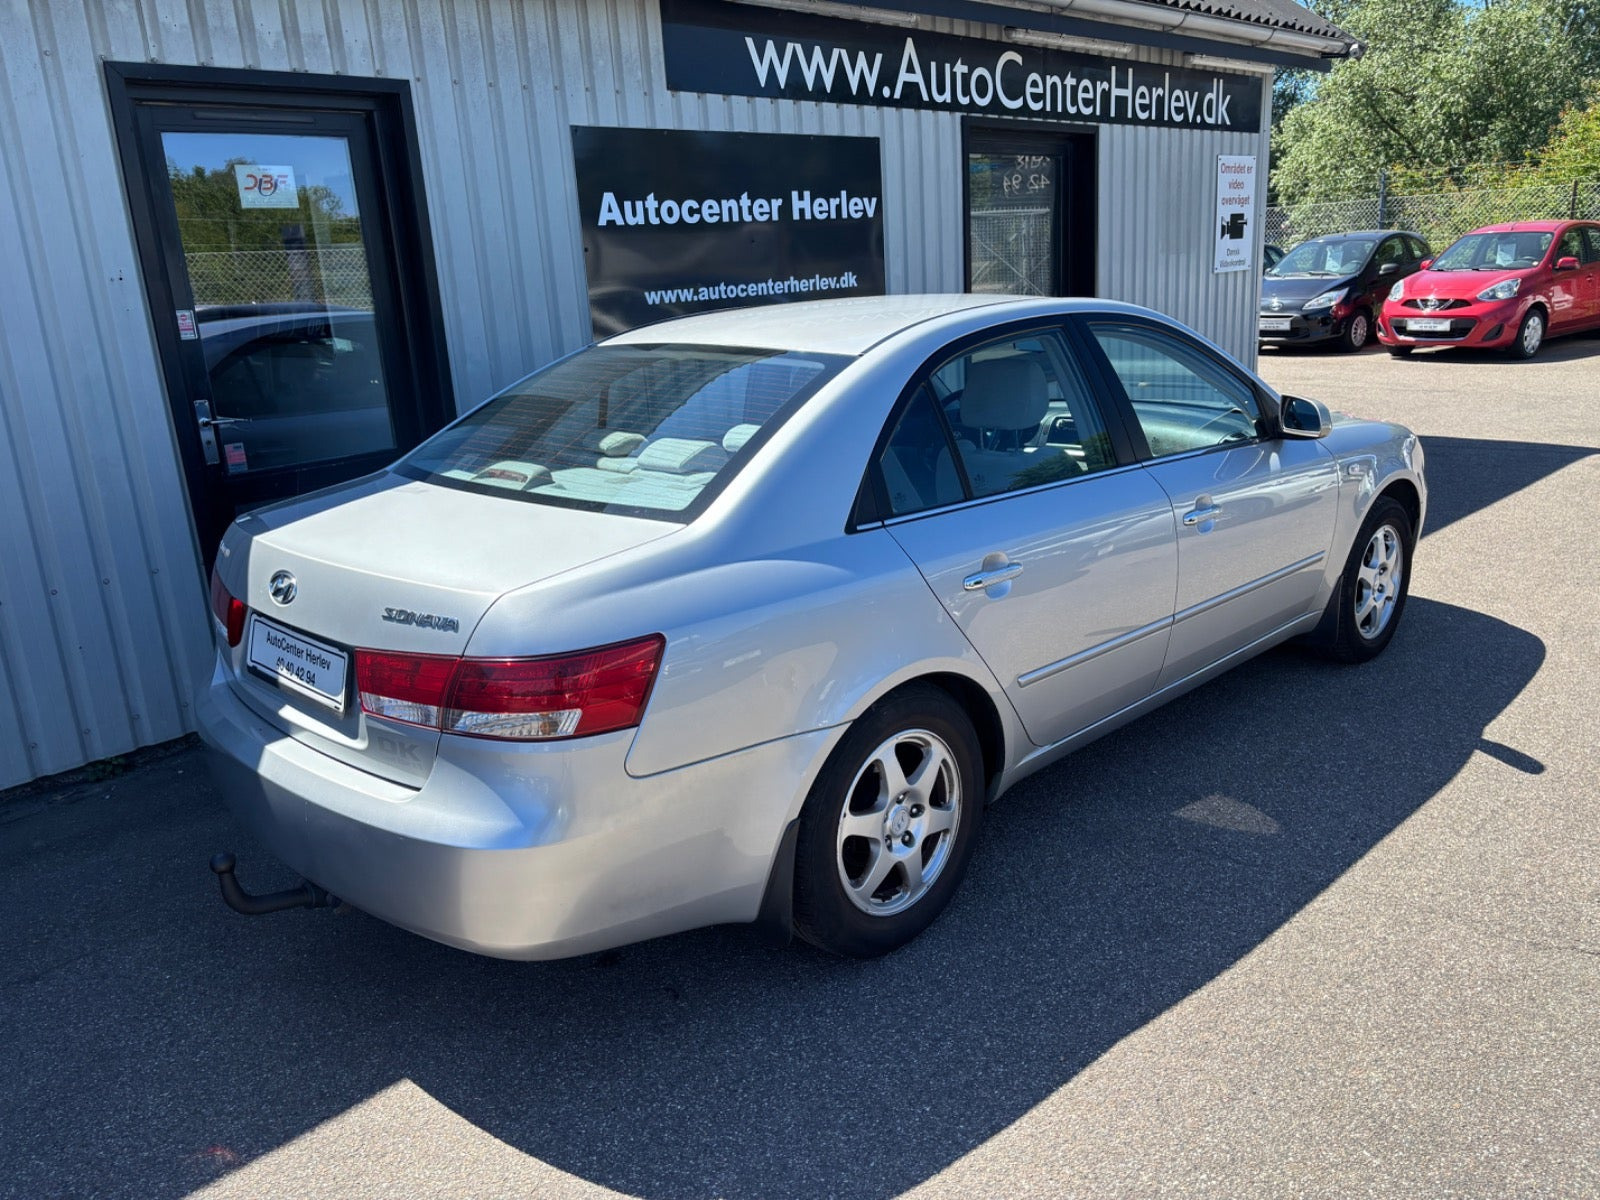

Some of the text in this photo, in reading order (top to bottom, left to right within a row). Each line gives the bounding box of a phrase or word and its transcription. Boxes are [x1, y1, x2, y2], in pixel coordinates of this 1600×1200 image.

[1221, 162, 1253, 175] Området er
[1228, 178, 1245, 190] video
[597, 189, 878, 226] Autocenter Herlev
[1221, 193, 1250, 208] overvåget
[644, 271, 858, 305] www.autocenterherlev.dk
[381, 606, 460, 634] SONATA
[266, 631, 332, 671] AutoCenter Herlev
[295, 666, 305, 681] 42
[305, 670, 317, 687] 94
